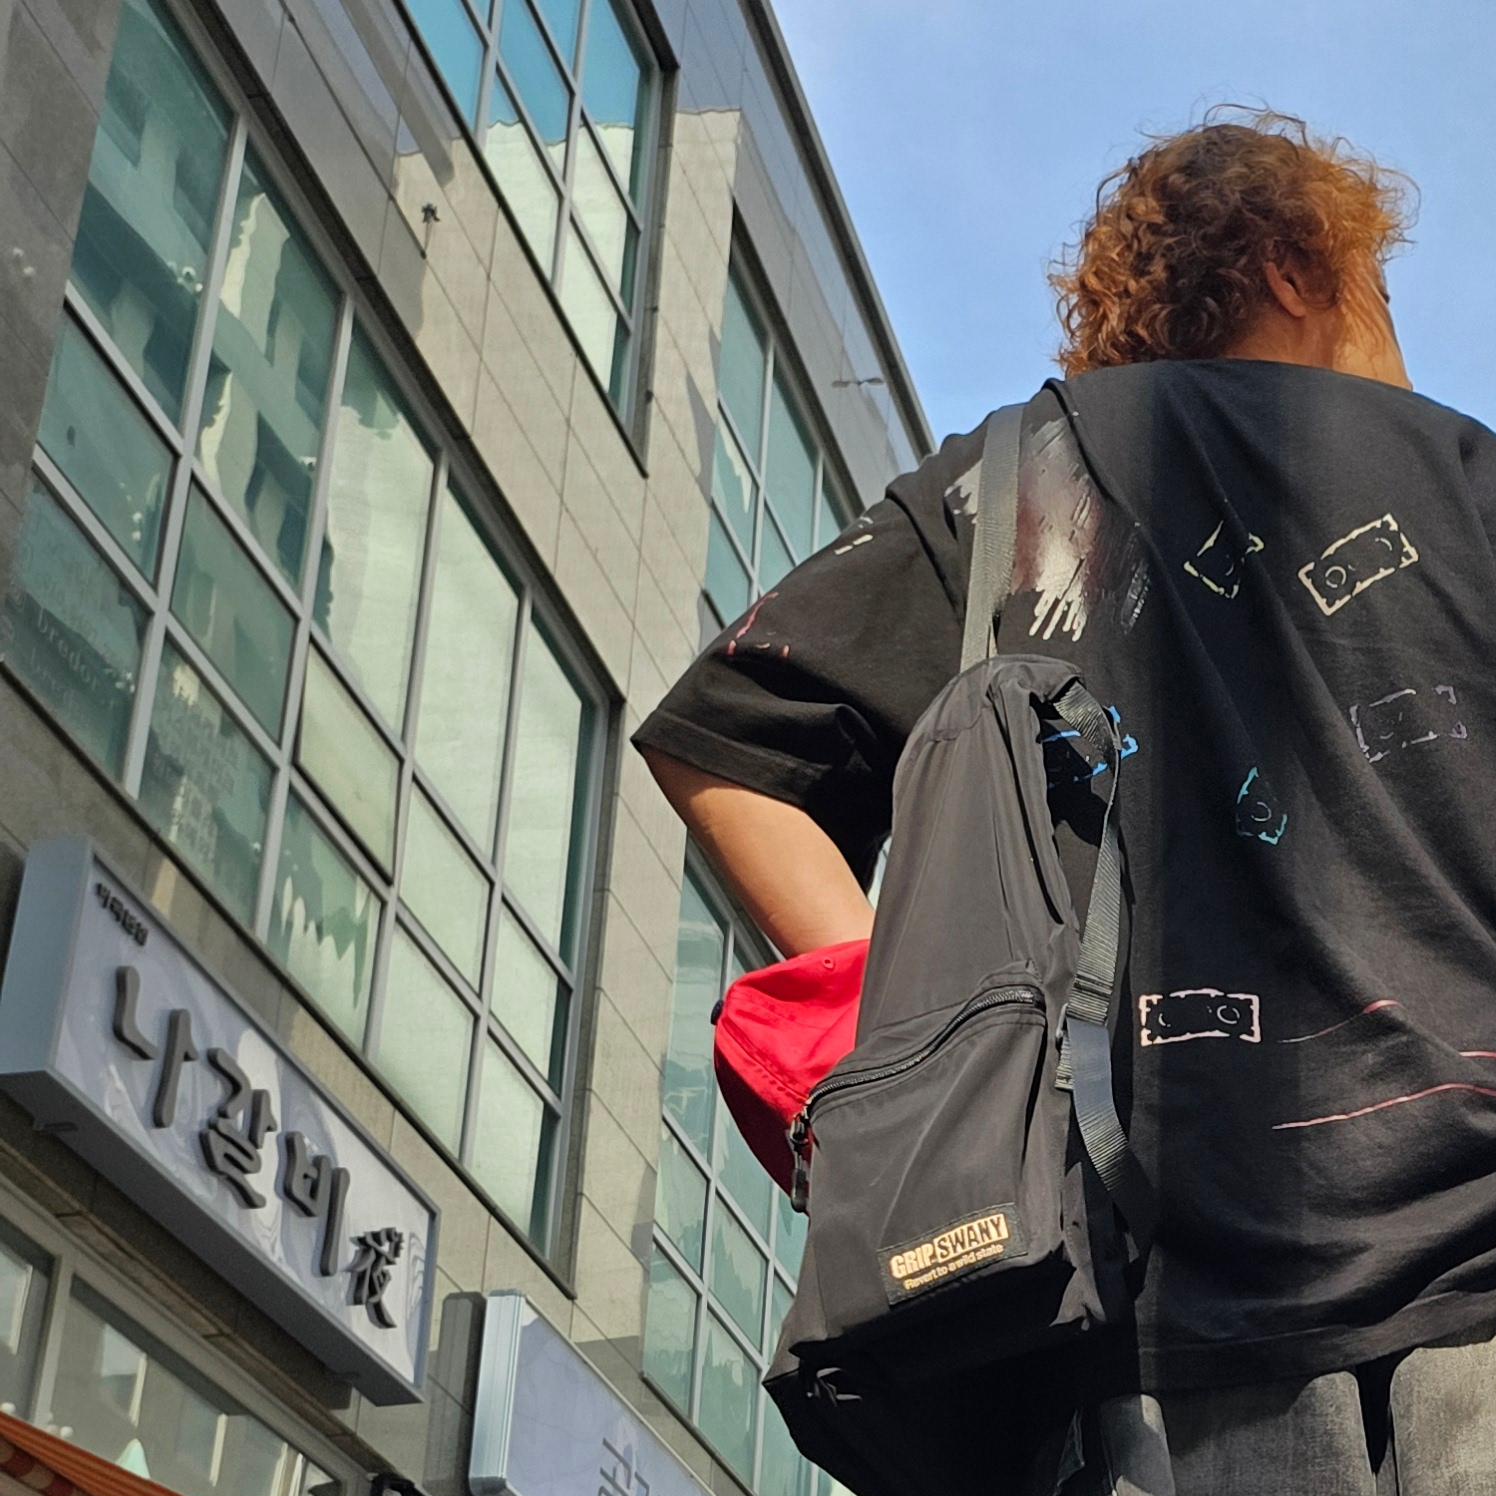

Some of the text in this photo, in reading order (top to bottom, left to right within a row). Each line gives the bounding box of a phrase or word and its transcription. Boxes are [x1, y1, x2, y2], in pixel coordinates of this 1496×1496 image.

[890, 1215, 1005, 1279] GRIP SWANY
[936, 1266, 948, 1278] to
[955, 1251, 976, 1268] wild
[975, 1243, 1004, 1260] state
